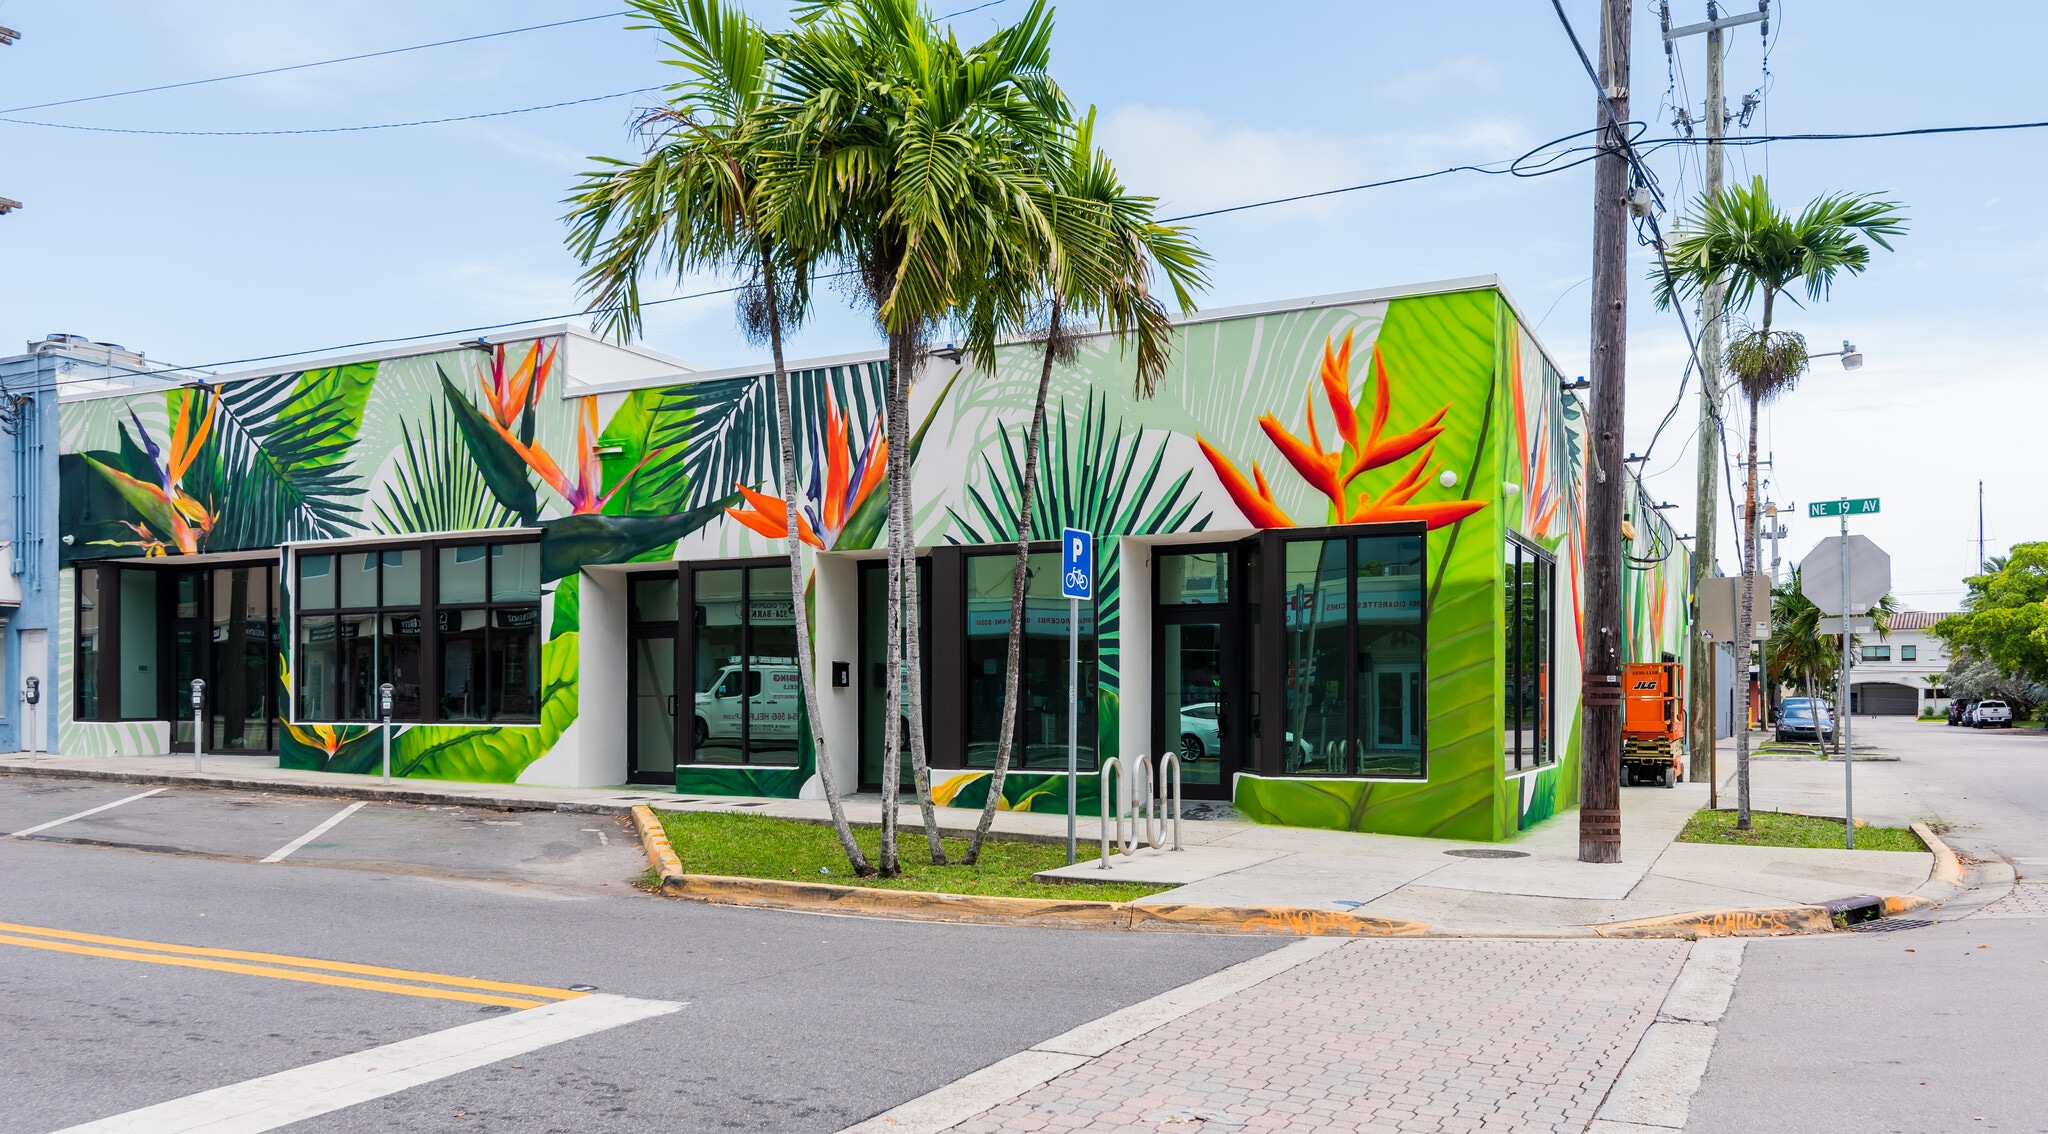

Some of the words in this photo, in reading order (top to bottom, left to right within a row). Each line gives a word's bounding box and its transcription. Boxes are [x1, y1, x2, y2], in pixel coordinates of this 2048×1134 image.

[1811, 503, 1827, 516] NE
[1838, 501, 1850, 514] 19
[1862, 499, 1877, 512] AV
[1072, 537, 1083, 563] P
[1633, 681, 1657, 690] JLG
